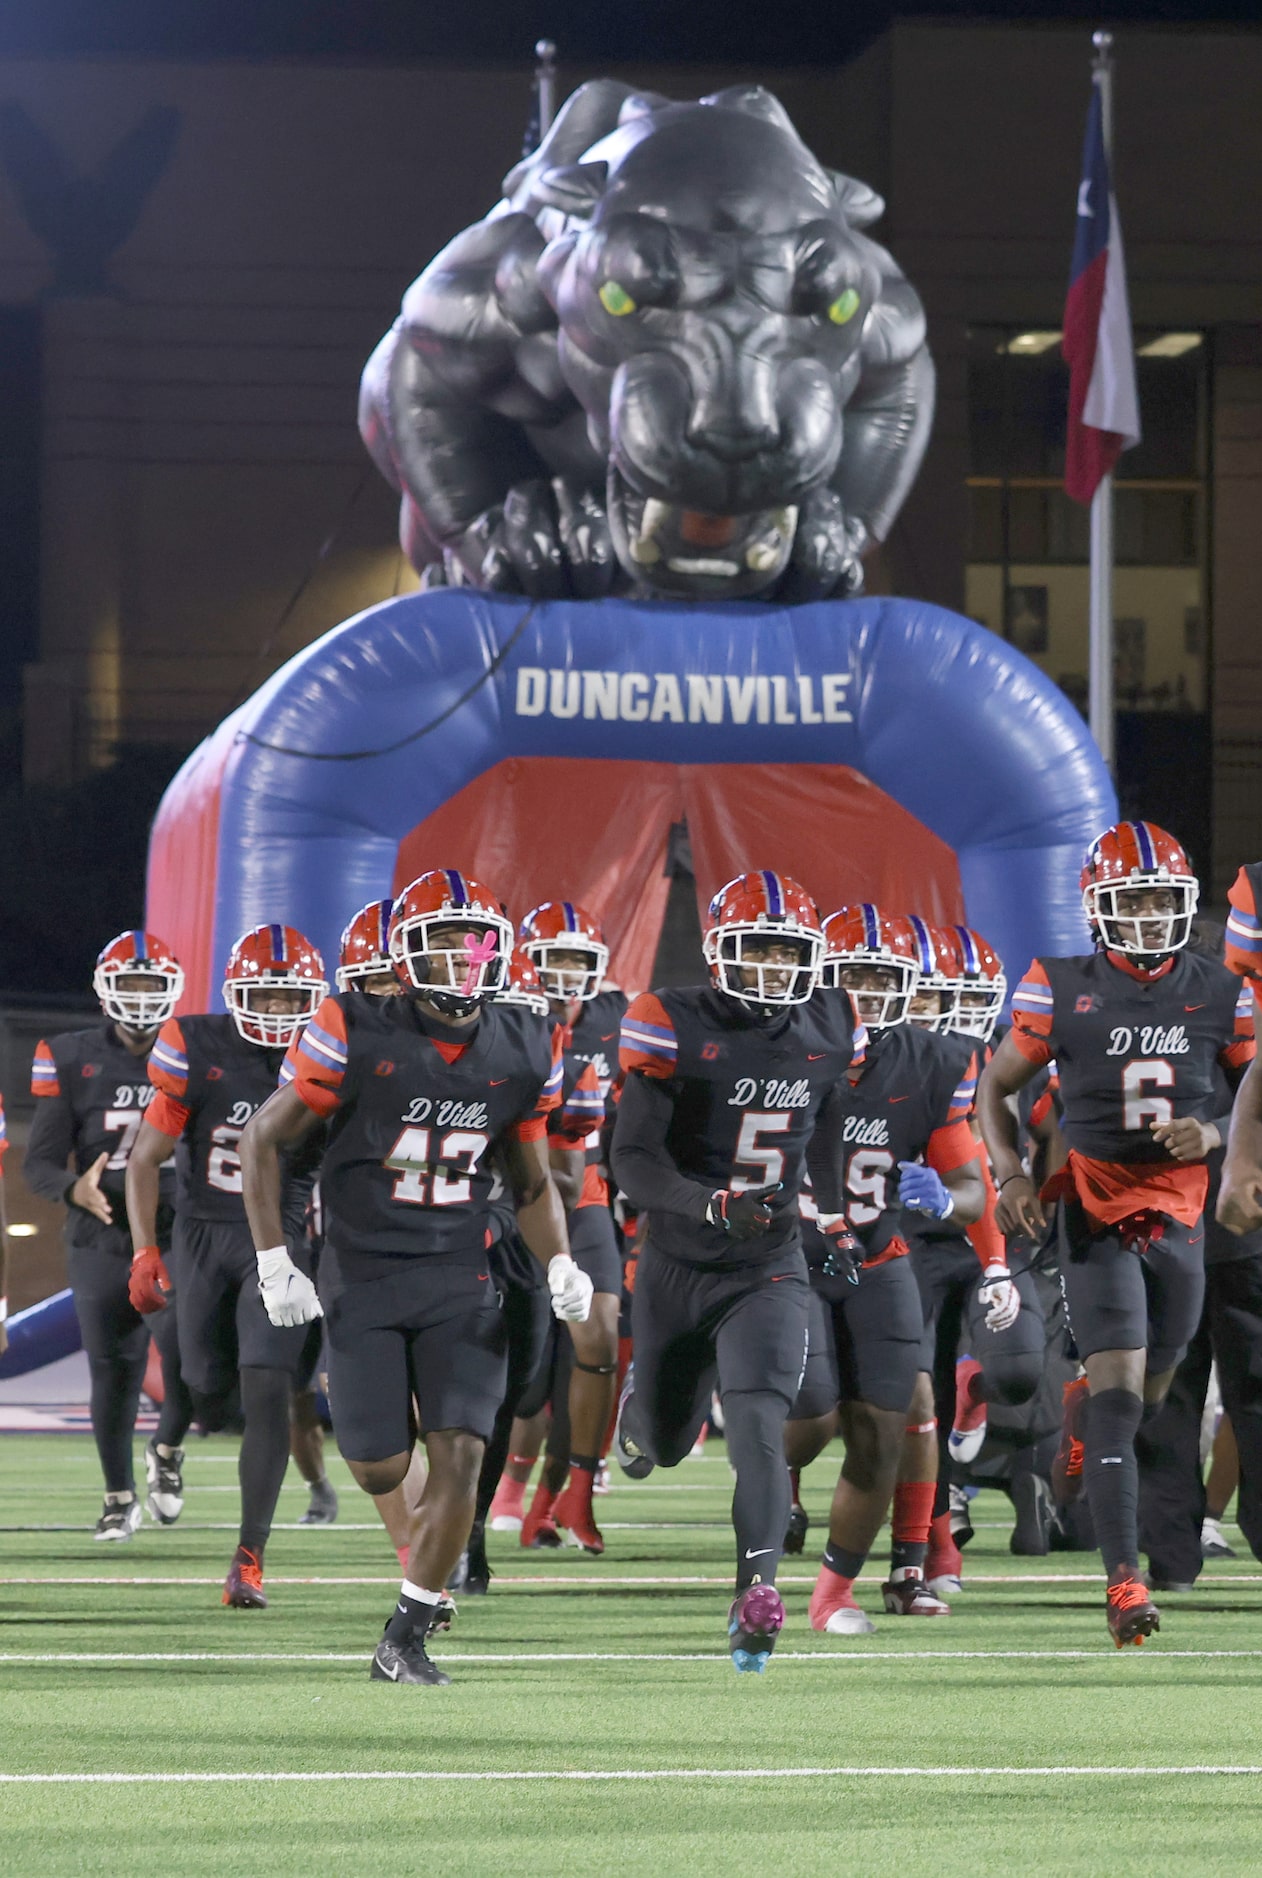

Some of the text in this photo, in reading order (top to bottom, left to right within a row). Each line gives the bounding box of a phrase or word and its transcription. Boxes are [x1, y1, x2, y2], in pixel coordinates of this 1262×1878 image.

[516, 667, 854, 725] DUNCANVILLE
[1106, 1025, 1190, 1056] D'Ville
[401, 1097, 488, 1129] D'Ville
[728, 1078, 811, 1109] D'Ville
[1121, 1058, 1176, 1131] 6
[104, 1109, 145, 1171] 7
[207, 1125, 243, 1195] 2
[729, 1110, 793, 1192] 5
[842, 1115, 889, 1146] Ville
[382, 1125, 490, 1206] 42
